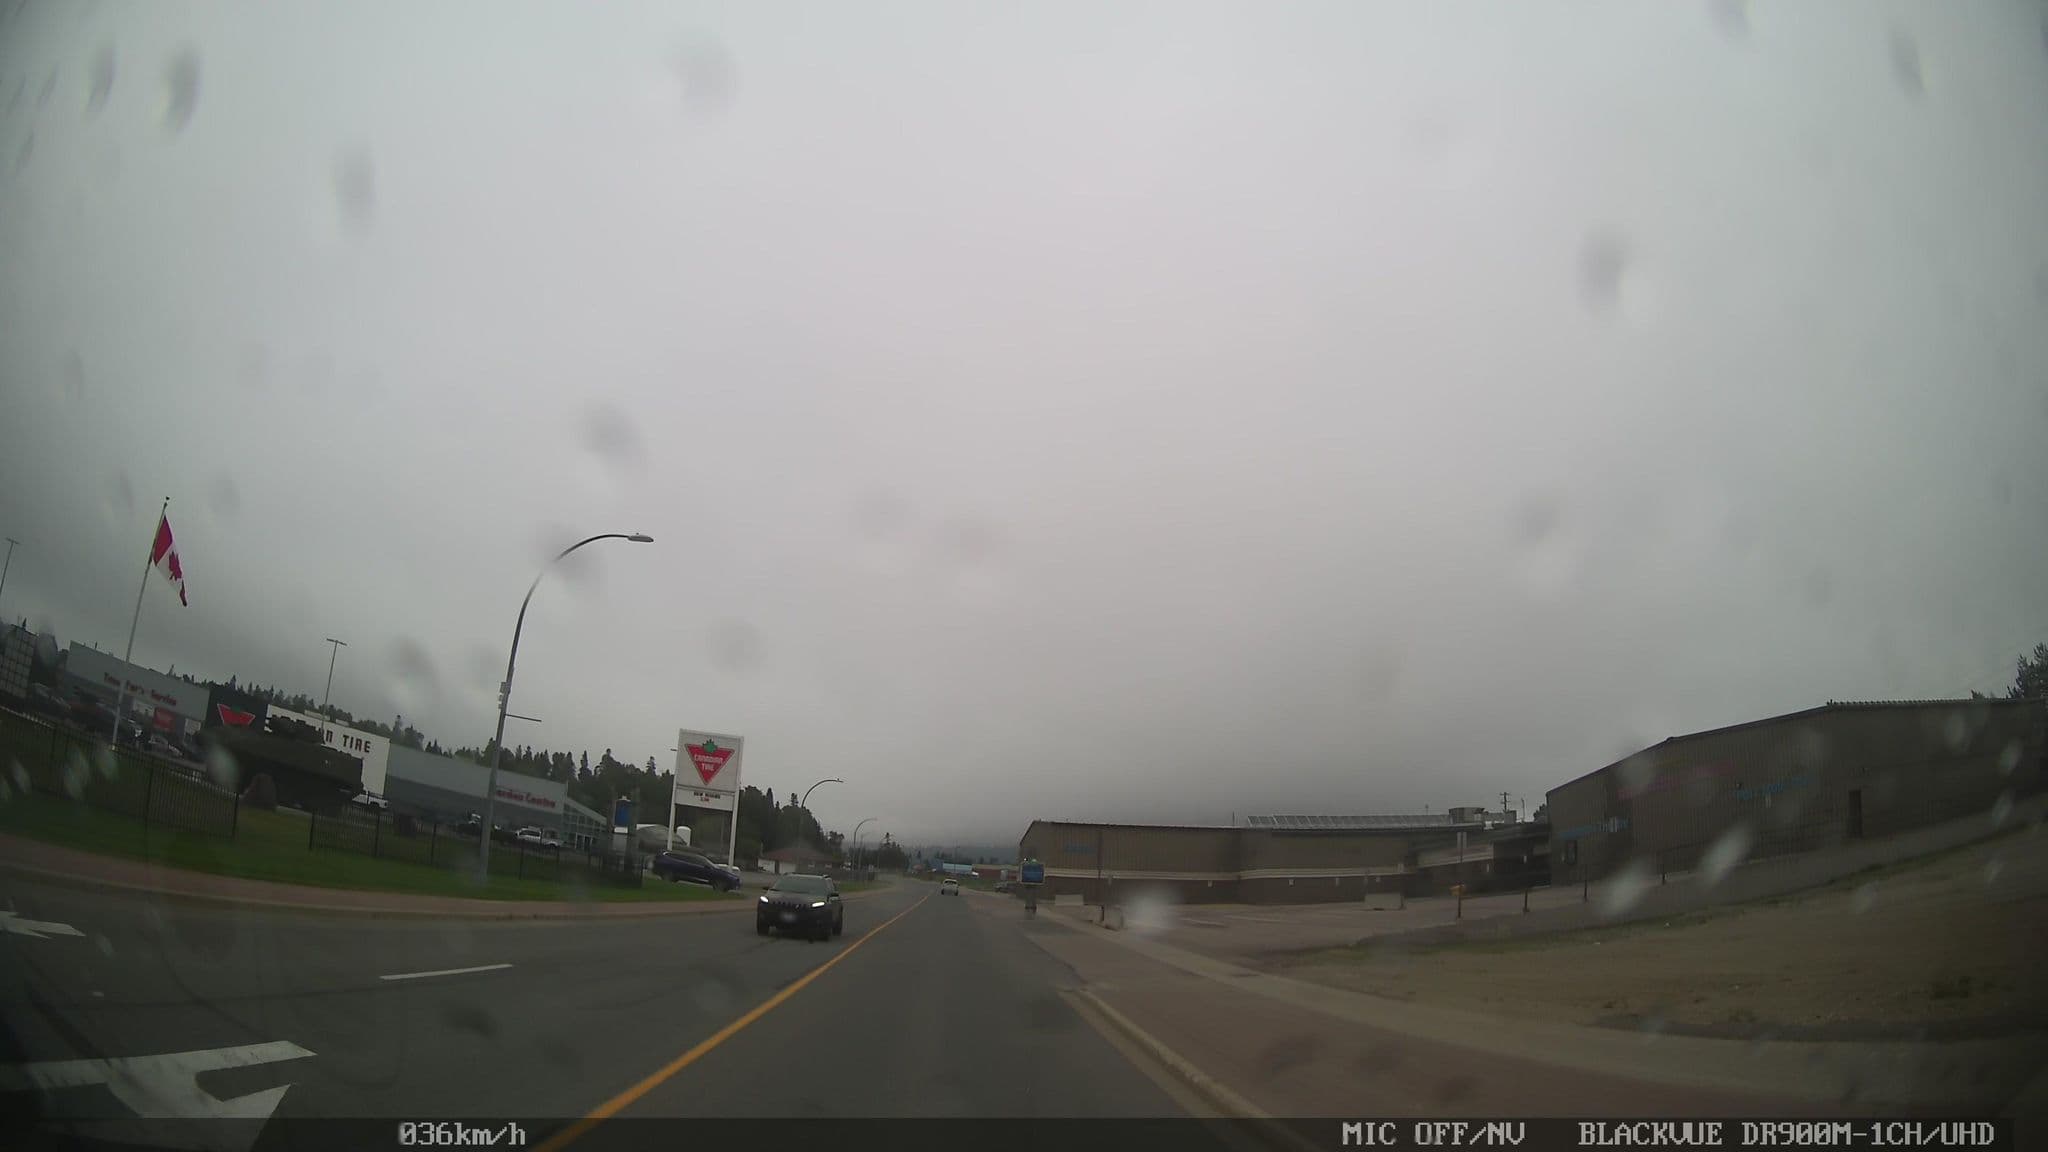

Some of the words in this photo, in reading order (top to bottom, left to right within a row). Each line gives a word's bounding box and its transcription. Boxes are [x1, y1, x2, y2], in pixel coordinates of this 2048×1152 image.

[342, 734, 371, 753] TIRE
[694, 754, 723, 764] CANADIAN
[702, 763, 715, 772] TIRE
[495, 789, 523, 801] arden
